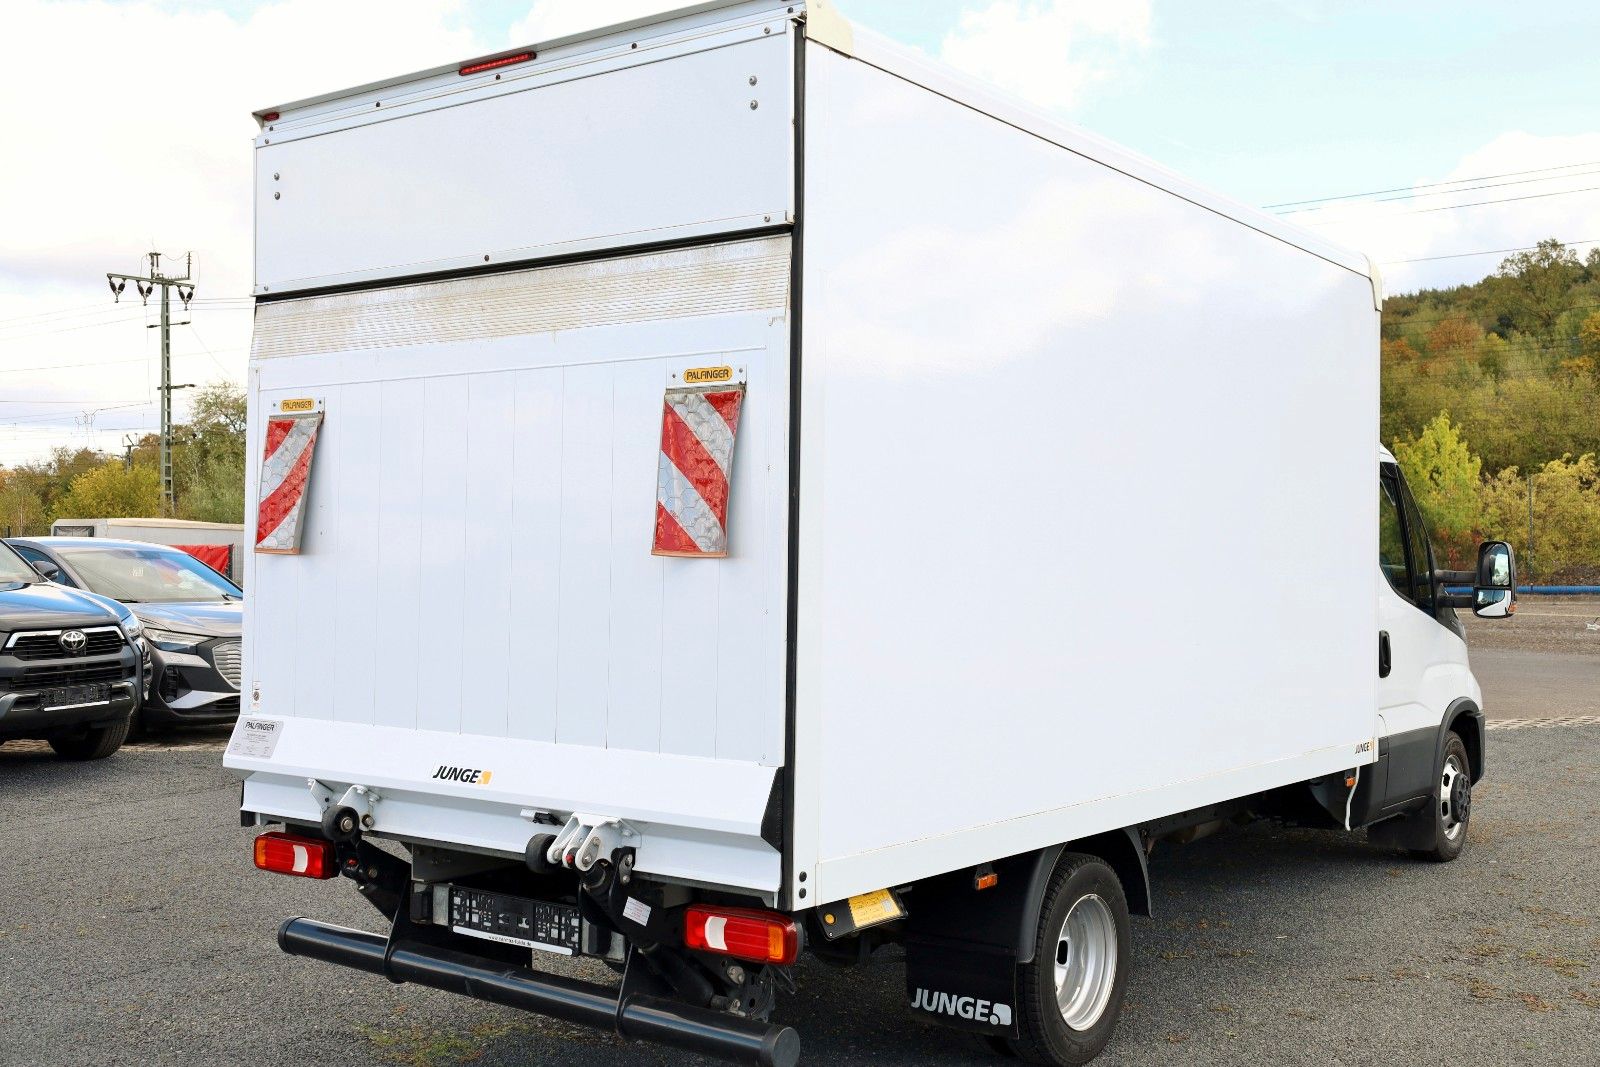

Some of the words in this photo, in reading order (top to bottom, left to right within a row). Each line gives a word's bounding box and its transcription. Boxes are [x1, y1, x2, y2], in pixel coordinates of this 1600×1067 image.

[687, 369, 730, 380] PALFINGER
[245, 721, 275, 731] PALFINGER
[432, 765, 482, 784] JUNGE
[910, 987, 991, 1022] JUNGE
